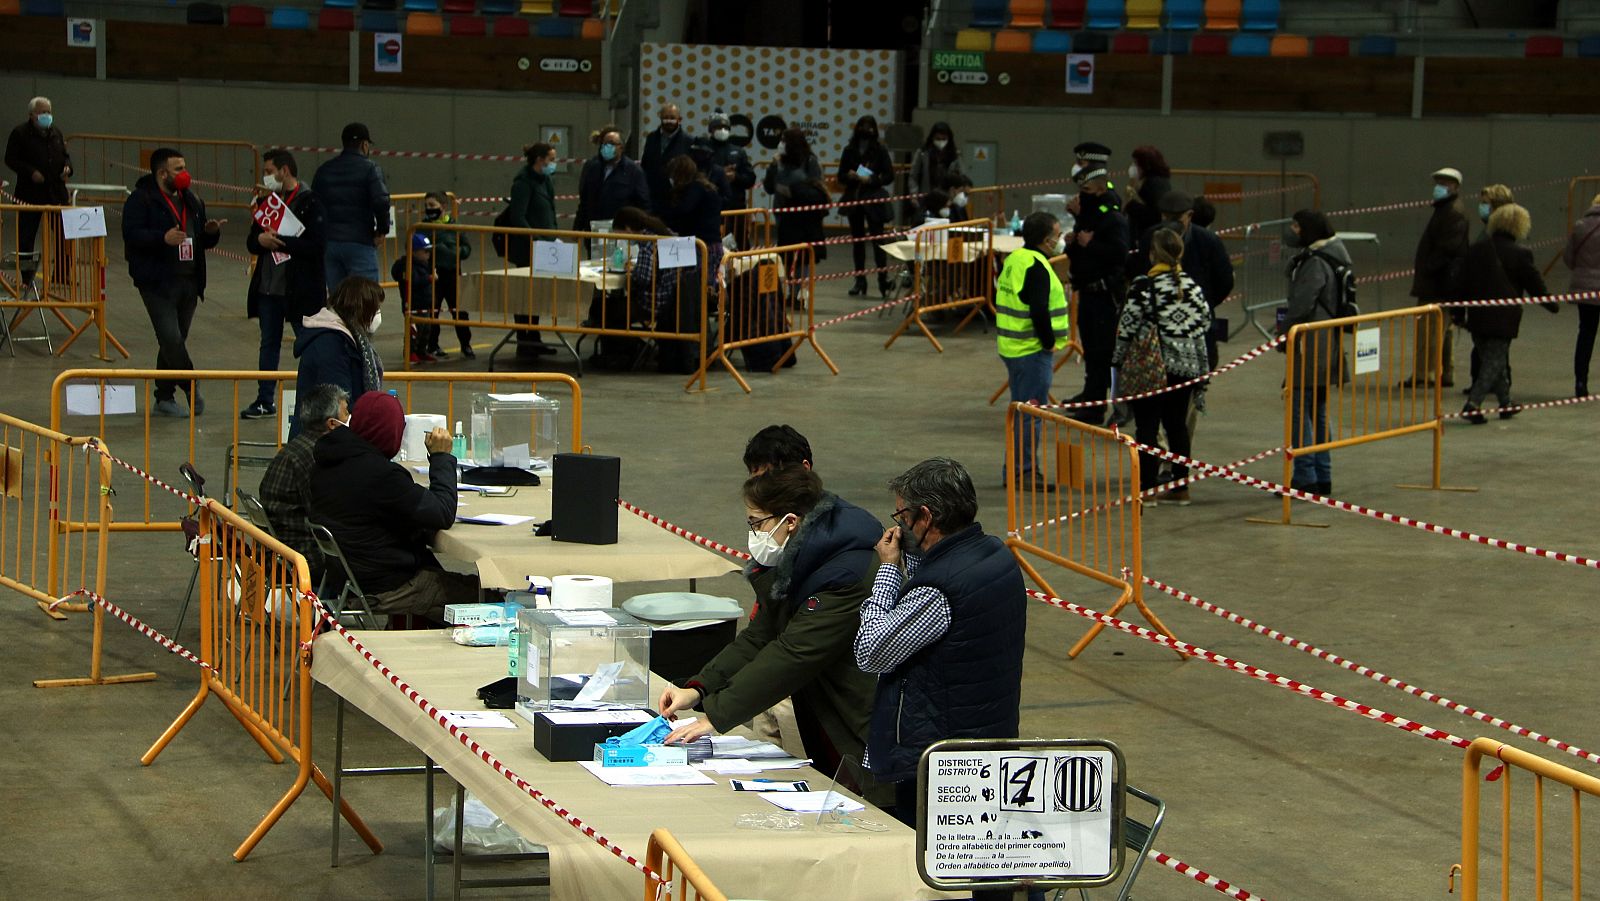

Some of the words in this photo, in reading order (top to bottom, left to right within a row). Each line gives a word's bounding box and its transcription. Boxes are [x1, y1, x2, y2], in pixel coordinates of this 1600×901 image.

[935, 53, 981, 67] SORTIDA
[78, 212, 92, 231] 2
[549, 246, 559, 266] 3
[668, 243, 680, 262] 4
[938, 759, 983, 767] DISTRICTE
[938, 768, 978, 776] DISTRITO
[979, 764, 992, 779] 6
[937, 784, 971, 794] SECCIÓ
[937, 794, 977, 803] SECCIÓN
[937, 814, 975, 826] MESA
[936, 833, 947, 841] De
[948, 833, 955, 841] la
[956, 833, 976, 841] lletra
[936, 843, 960, 851] (Ordre
[994, 842, 1006, 850] del
[1007, 842, 1031, 851] primer
[1032, 841, 1066, 851] cognom)
[948, 852, 955, 860] la
[956, 852, 974, 860] letra
[936, 862, 962, 871] (Orden
[1001, 861, 1013, 869] del
[1013, 861, 1037, 870] primer
[1038, 860, 1072, 870] apellido)
